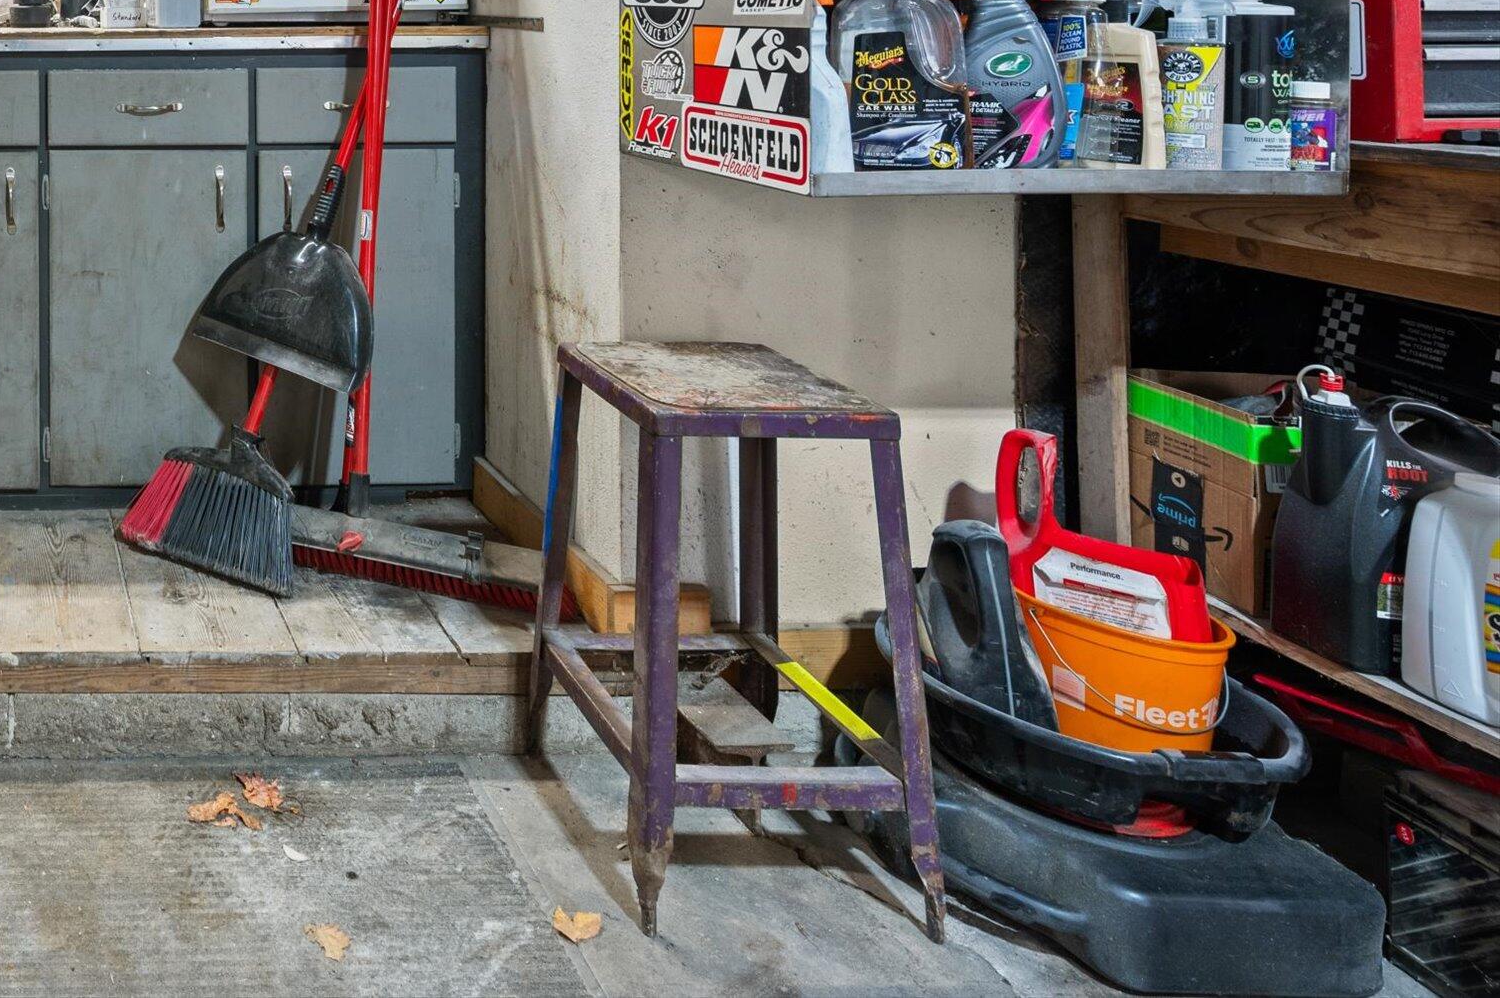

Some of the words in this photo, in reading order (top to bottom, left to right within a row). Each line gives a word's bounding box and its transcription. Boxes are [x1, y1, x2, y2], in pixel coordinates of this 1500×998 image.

[641, 19, 662, 40] SINCE
[663, 19, 682, 40] 2003
[1061, 29, 1082, 38] OCEAN
[1062, 22, 1081, 31] 100%
[1058, 42, 1083, 51] PLASTIC
[855, 46, 904, 68] Meguiar's
[854, 74, 912, 93] GOLD
[1168, 72, 1194, 82] GUYS
[861, 90, 917, 106] CLASS
[635, 106, 679, 150] K1
[627, 140, 676, 160] RaceGear
[689, 116, 801, 173] SCHOENFELD
[719, 153, 761, 181] Headers
[1386, 459, 1412, 470] KILLS
[1386, 469, 1429, 483] ROOT
